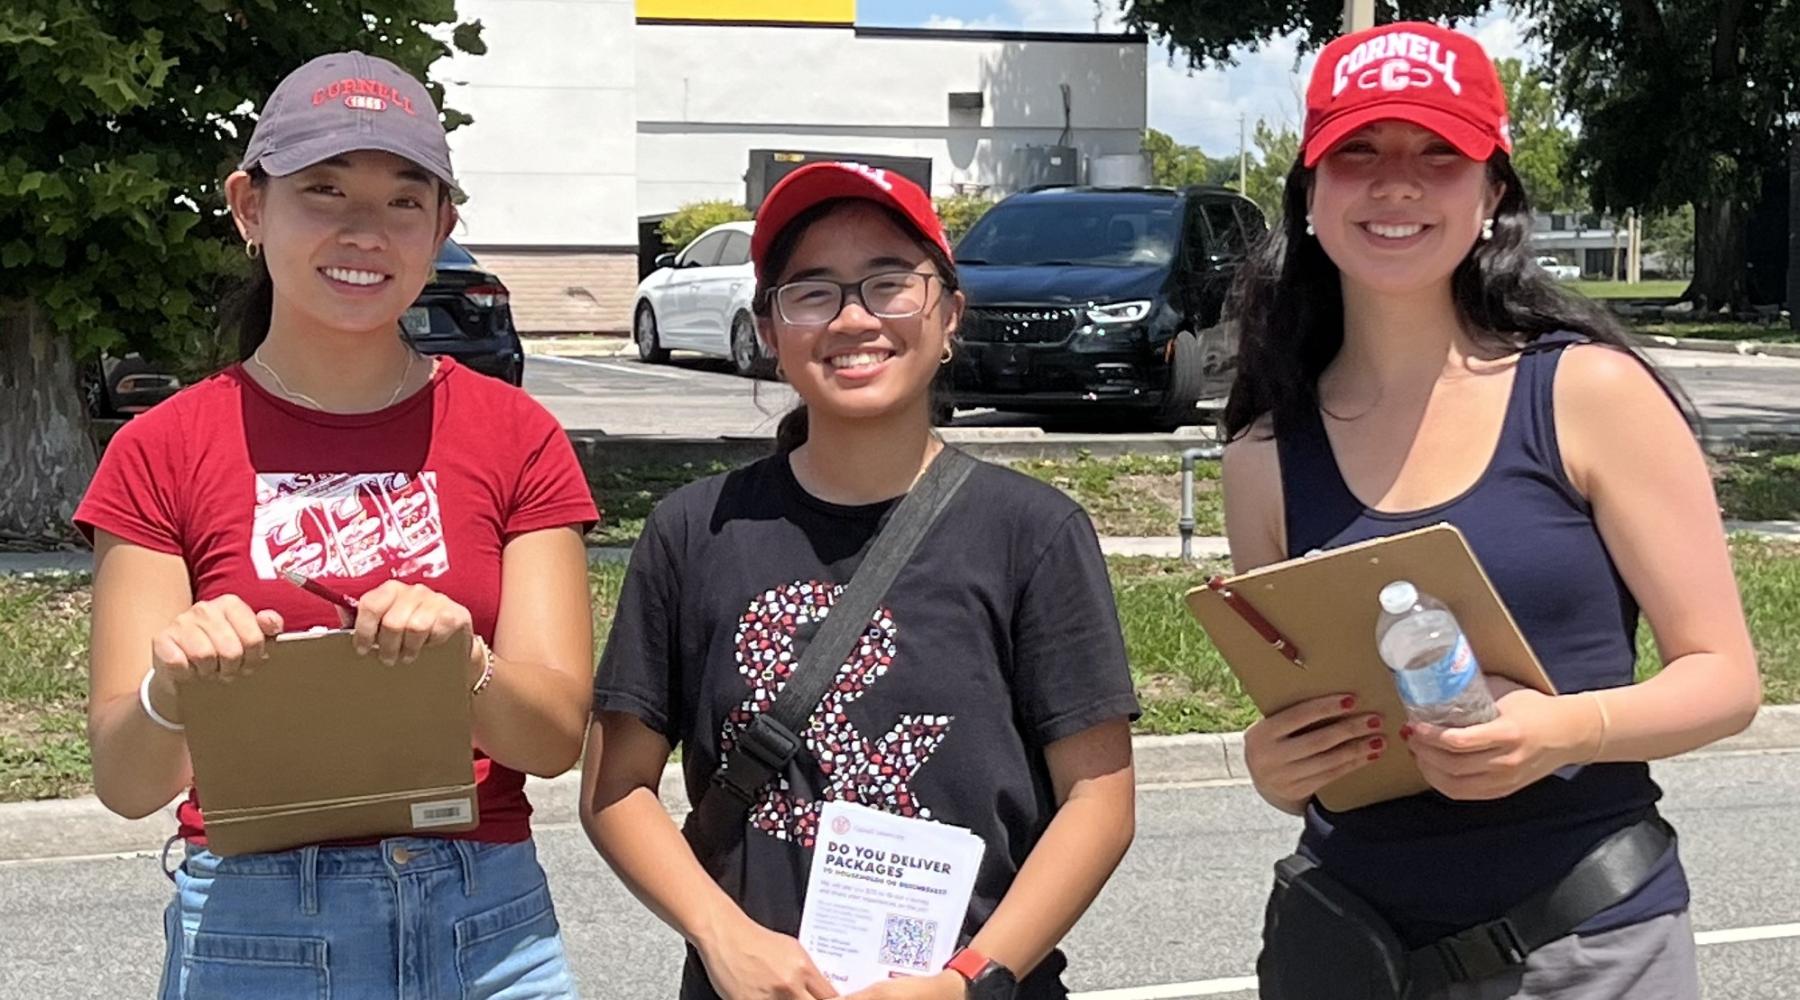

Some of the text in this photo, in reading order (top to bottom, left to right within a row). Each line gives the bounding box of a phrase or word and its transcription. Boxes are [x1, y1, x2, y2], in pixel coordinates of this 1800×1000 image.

[1332, 32, 1462, 97] CORNELL
[1380, 58, 1411, 92] C
[311, 78, 417, 116] CORNELL
[825, 854, 904, 878] PACKAGES
[828, 841, 952, 875] DO YOU DELIVER
